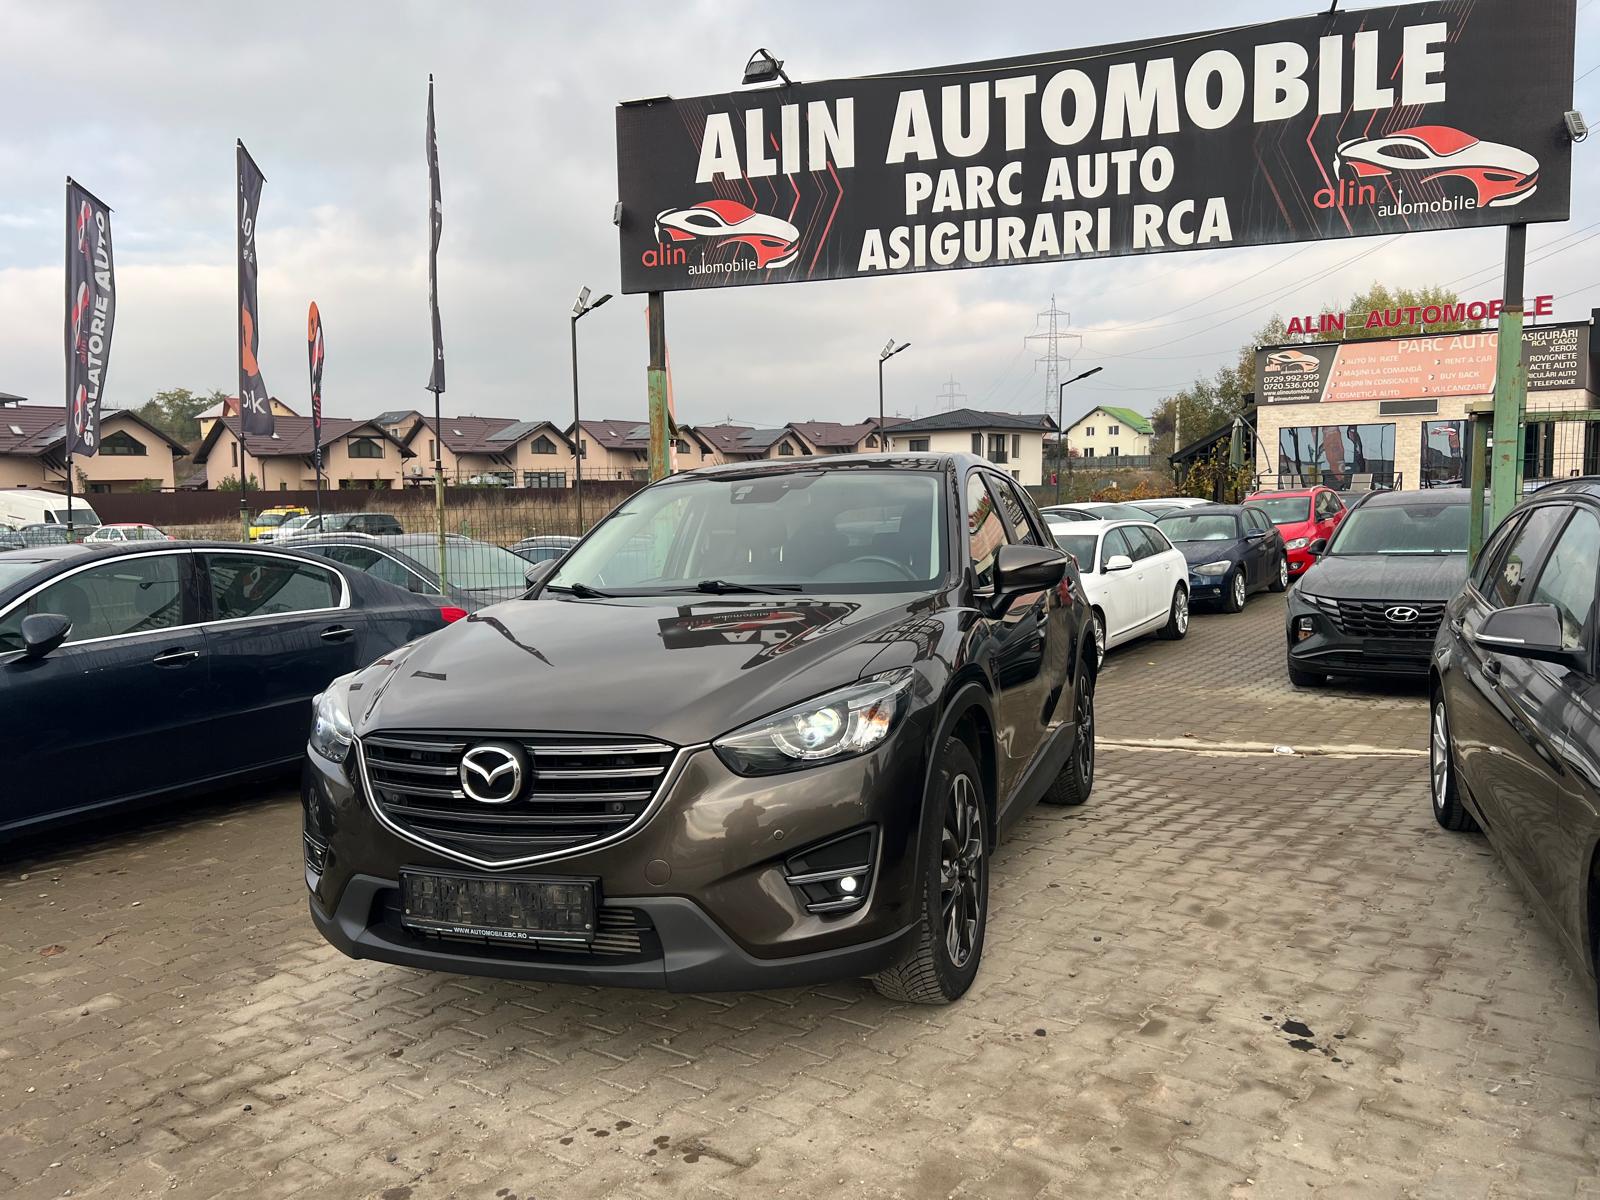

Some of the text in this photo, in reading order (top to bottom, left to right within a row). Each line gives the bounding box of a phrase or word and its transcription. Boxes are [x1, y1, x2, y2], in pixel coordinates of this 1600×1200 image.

[695, 22, 1447, 183] ALIN AUTOMOBILE
[905, 146, 1174, 216] PARC AUTO
[1313, 178, 1376, 209] alin
[1378, 189, 1475, 217] automobile
[857, 197, 1233, 272] ASIGURARI RCA
[95, 211, 111, 292] AUTO
[641, 242, 686, 267] alin
[688, 252, 757, 275] automobile
[1287, 295, 1553, 335] ALIN AUTOMOBE
[1521, 328, 1579, 341] ASIGURĂRI
[1398, 333, 1498, 353] PARC AUTO
[1552, 337, 1577, 345] CASCO
[1549, 344, 1578, 352] XEROX
[1445, 356, 1465, 364] RENT
[1476, 354, 1492, 363] CAR
[1529, 352, 1578, 362] ROVIGNETE
[1265, 363, 1280, 372] alin
[1529, 360, 1577, 371] ACTE AUTO
[1263, 373, 1320, 383] 0729.992.999
[1440, 370, 1480, 380] BUY BACK
[1263, 381, 1320, 390] 0720.536.000
[1533, 378, 1576, 387] TELEFONICE
[1380, 389, 1400, 397] AUTO
[453, 927, 528, 939] WWW.AUTOMOBILEBC.RO
